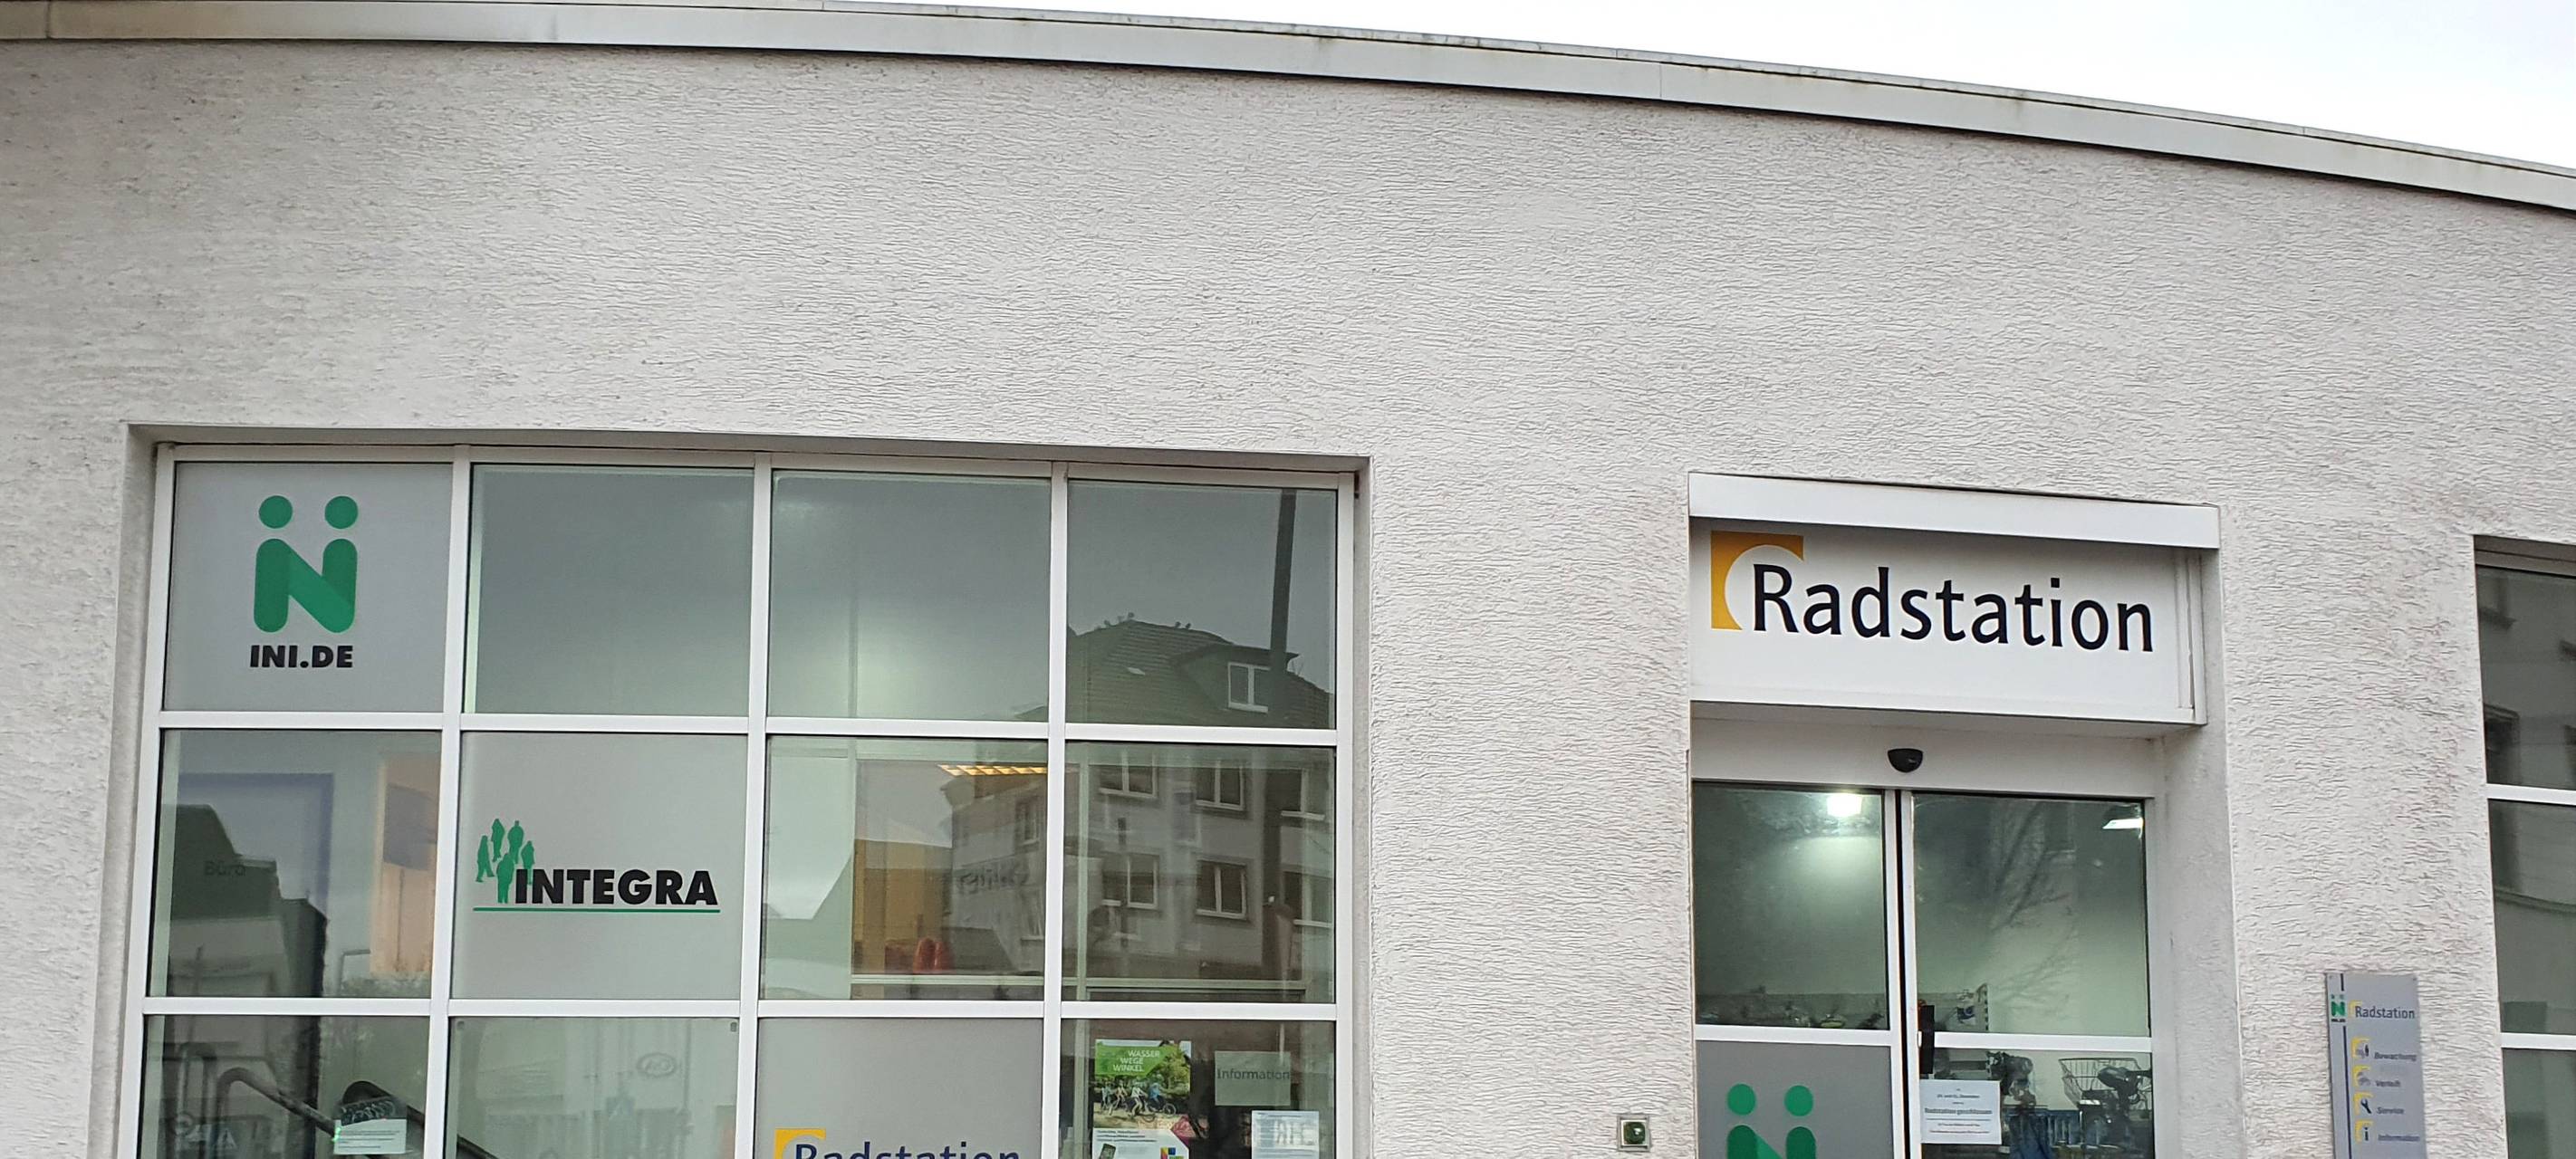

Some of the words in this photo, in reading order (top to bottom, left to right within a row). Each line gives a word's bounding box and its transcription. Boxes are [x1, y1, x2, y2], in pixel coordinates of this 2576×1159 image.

[1752, 562, 2154, 653] Radstation
[249, 645, 353, 668] INI.DE
[514, 868, 718, 905] INTEGRA
[2355, 1006, 2415, 1019] Radstation
[1120, 1057, 1144, 1065] WEGE
[1112, 1064, 1145, 1072] WINKEL
[1216, 1068, 1290, 1079] Information
